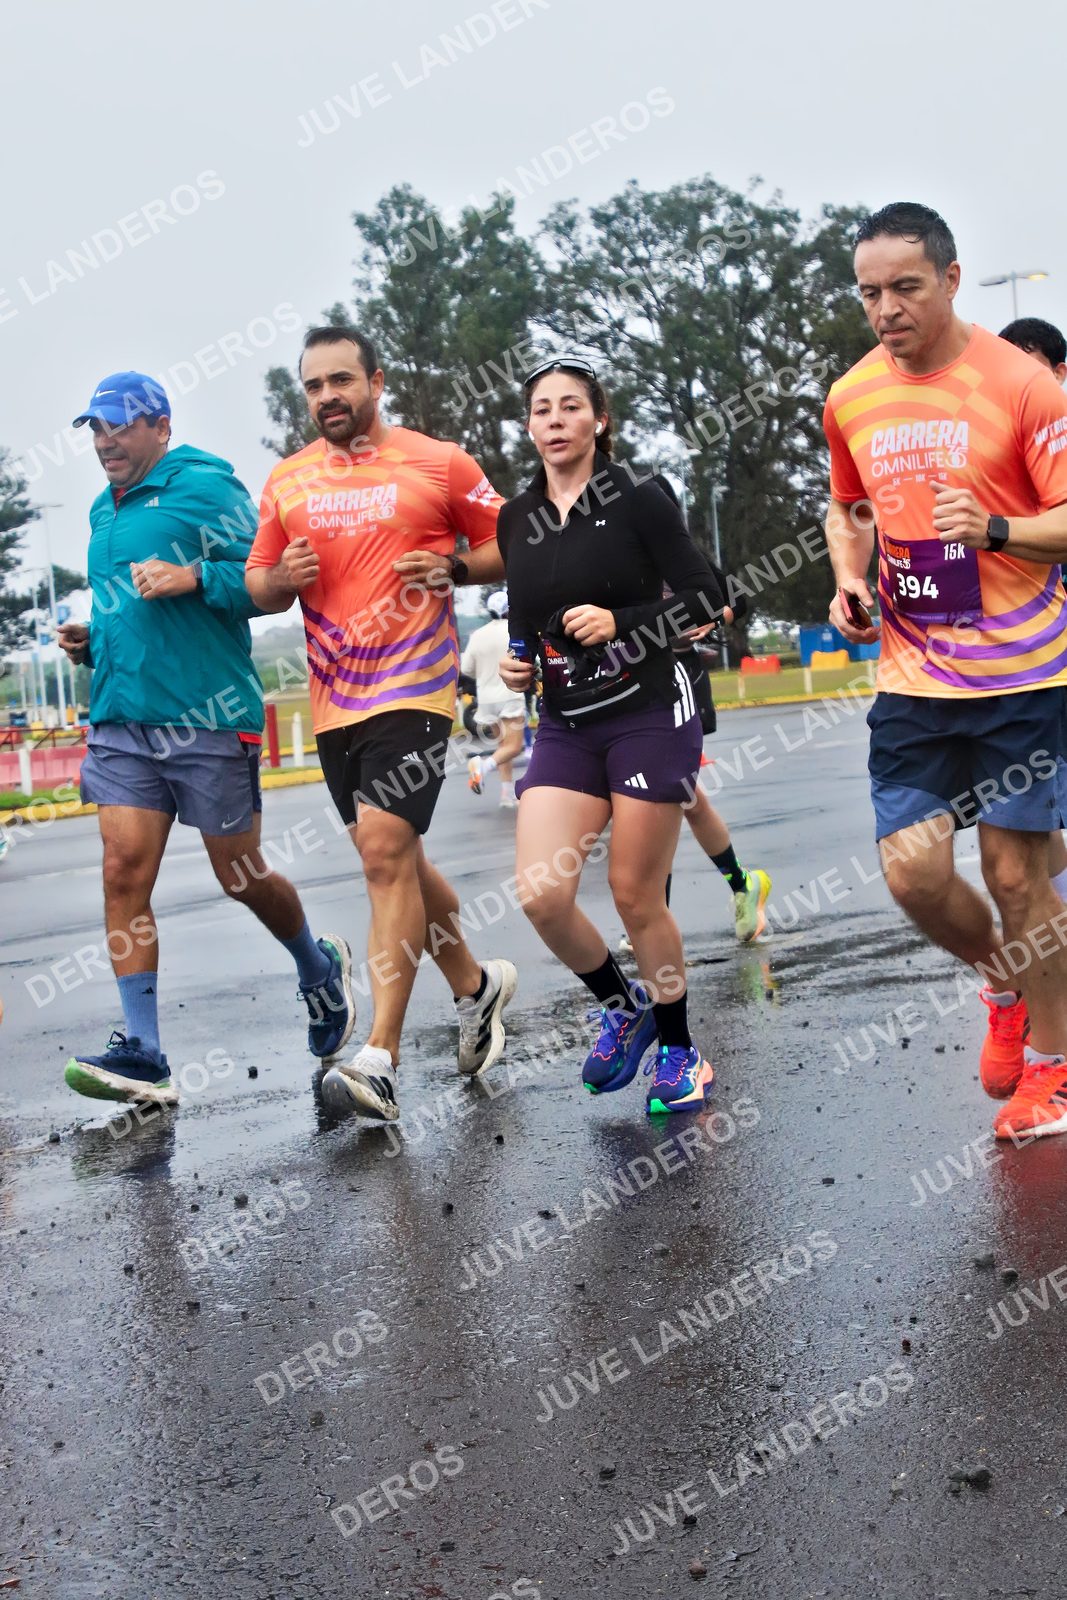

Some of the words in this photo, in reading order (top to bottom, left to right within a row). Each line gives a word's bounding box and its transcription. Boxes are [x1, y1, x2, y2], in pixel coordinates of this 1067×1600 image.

[871, 420, 968, 458] CARRERA
[872, 452, 944, 478] OMNILIFE
[308, 484, 397, 513] CARRERA
[308, 508, 375, 529] OMNILIFE
[944, 543, 966, 560] 15K
